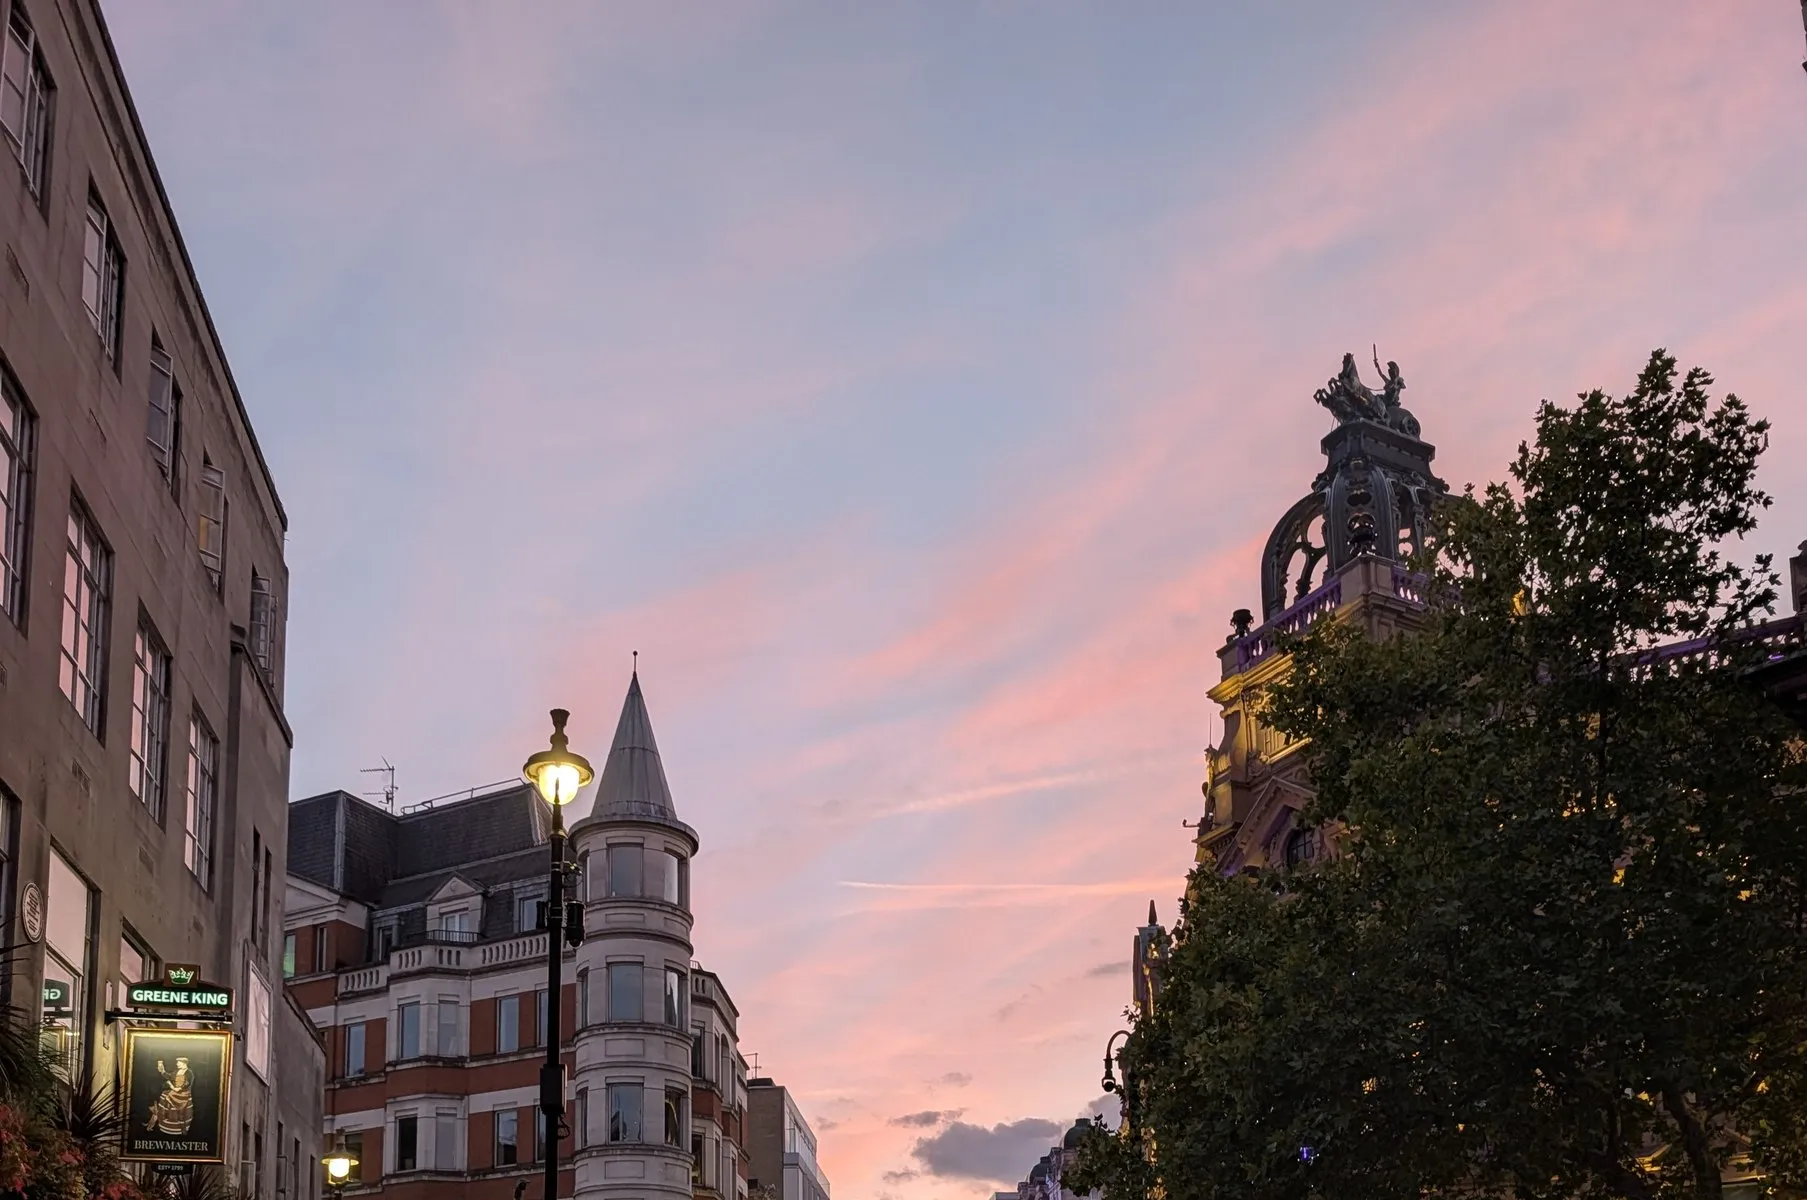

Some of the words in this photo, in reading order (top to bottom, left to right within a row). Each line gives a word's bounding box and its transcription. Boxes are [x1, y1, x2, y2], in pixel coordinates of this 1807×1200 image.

[132, 990, 190, 1004] GREENE
[191, 993, 229, 1005] KING
[134, 1139, 209, 1152] BREWMASTER
